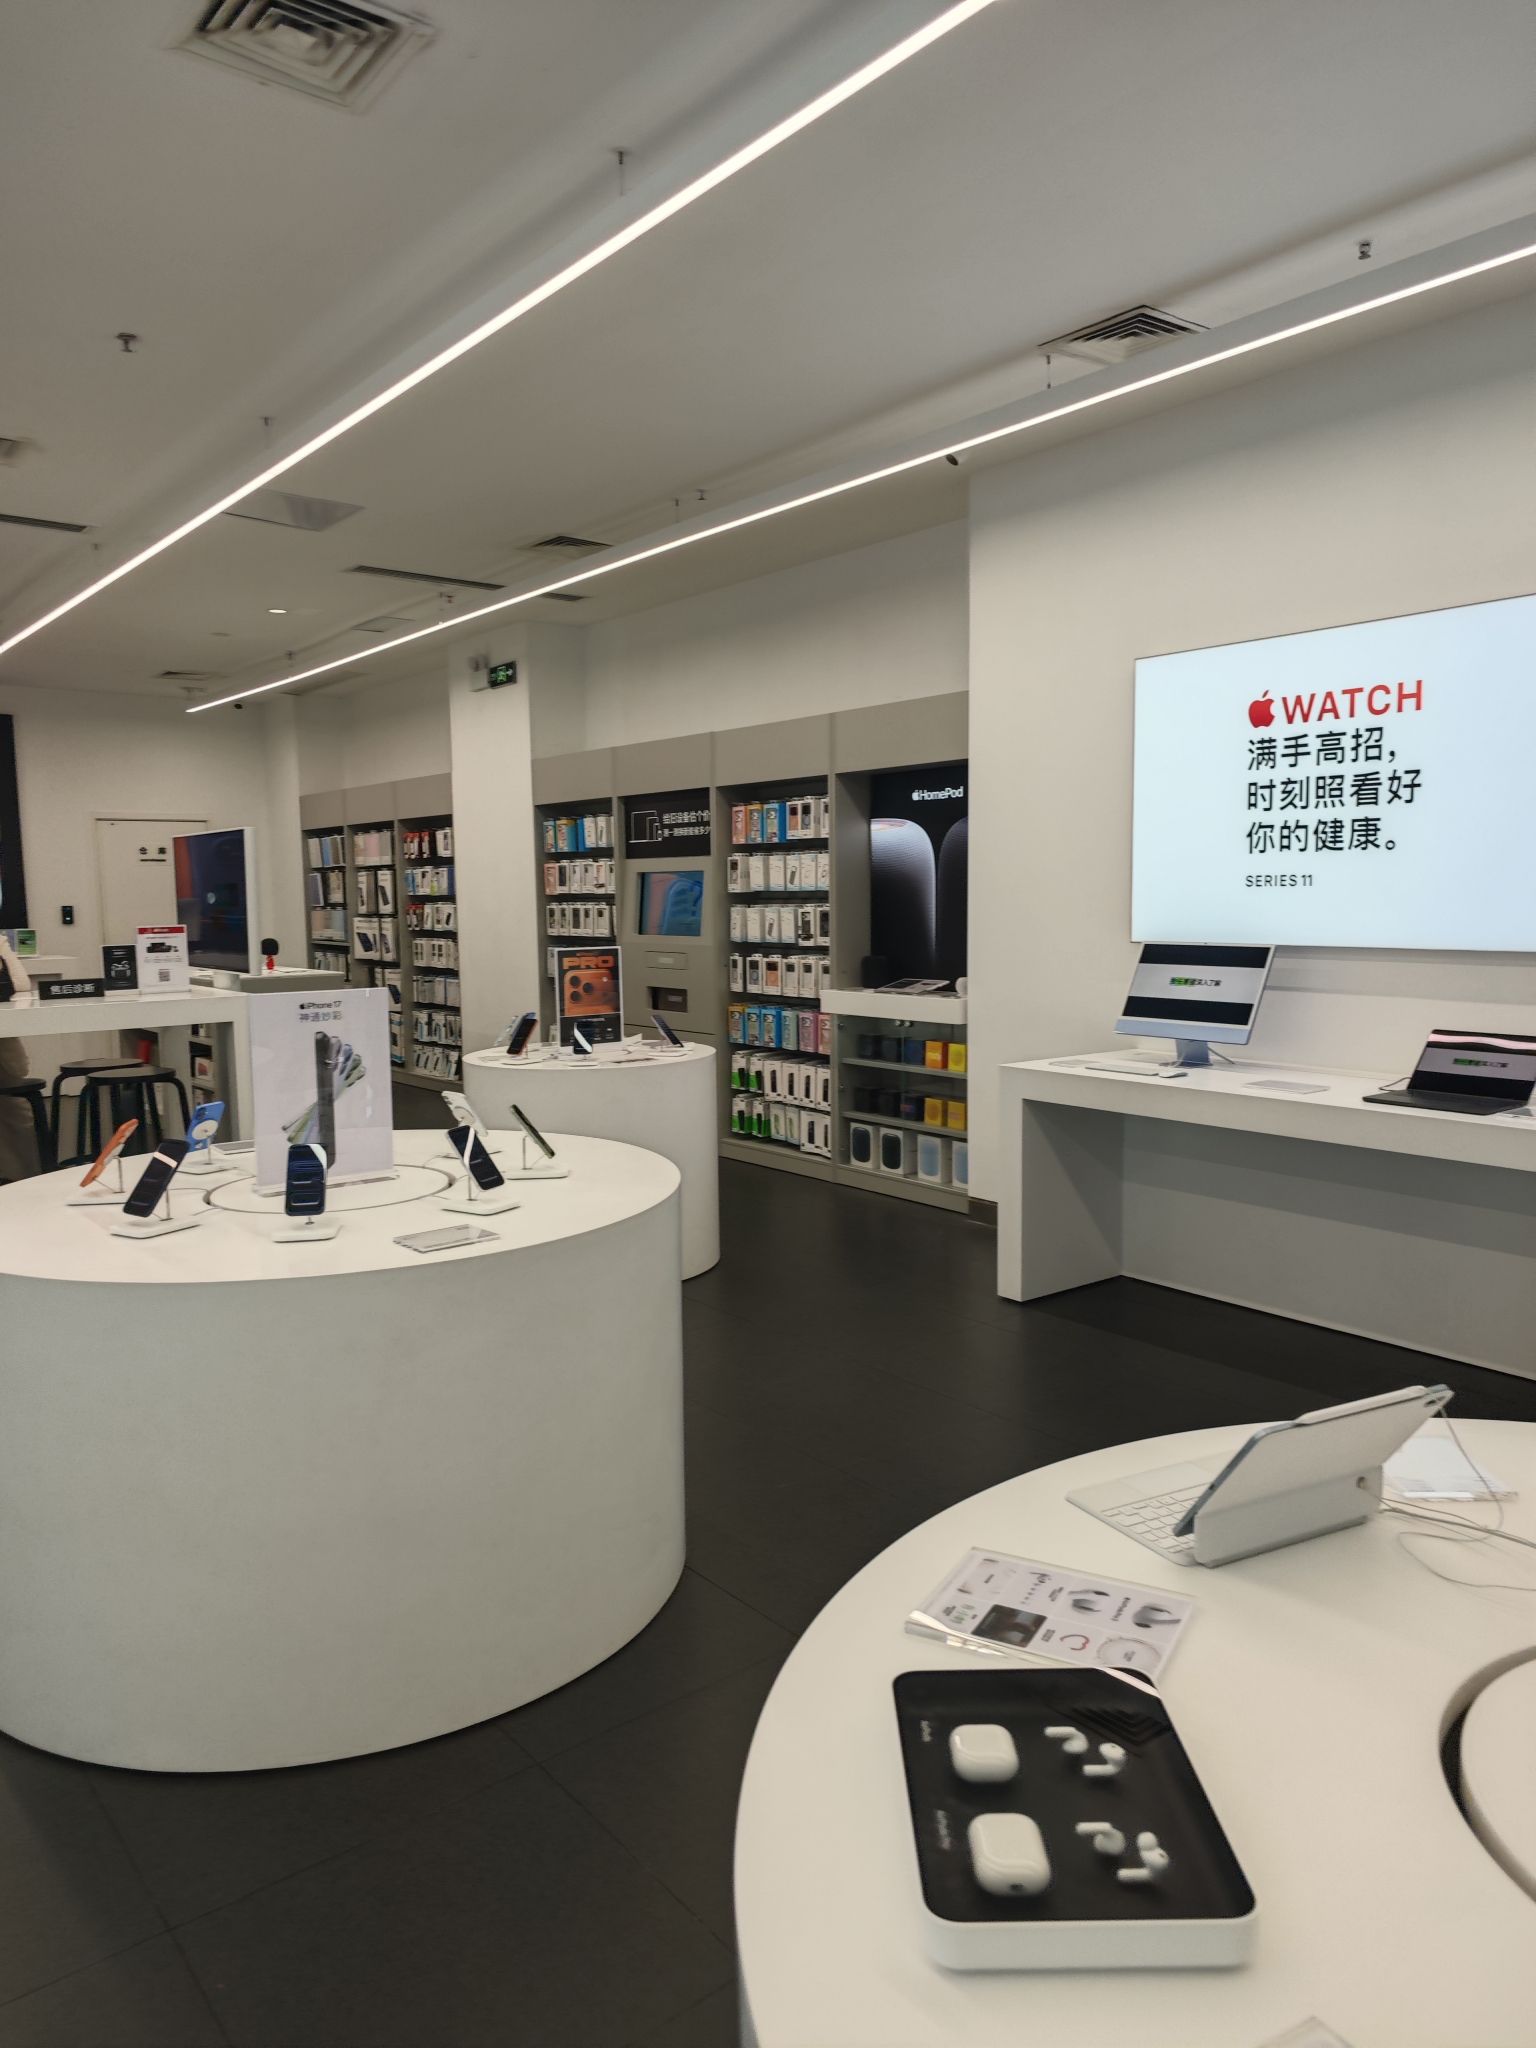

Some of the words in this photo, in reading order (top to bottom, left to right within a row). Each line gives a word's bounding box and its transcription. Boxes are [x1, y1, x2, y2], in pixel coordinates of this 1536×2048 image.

[1281, 679, 1423, 725] WATCH
[919, 785, 964, 801] HomePod
[1247, 769, 1422, 812] 时刻照看好
[1246, 816, 1397, 854] 你的健康。
[1245, 875, 1298, 888] SERIES
[1301, 874, 1314, 887] 11
[562, 955, 614, 970] PRO
[49, 982, 96, 996] 售后诊断
[305, 1001, 332, 1010] iPhone
